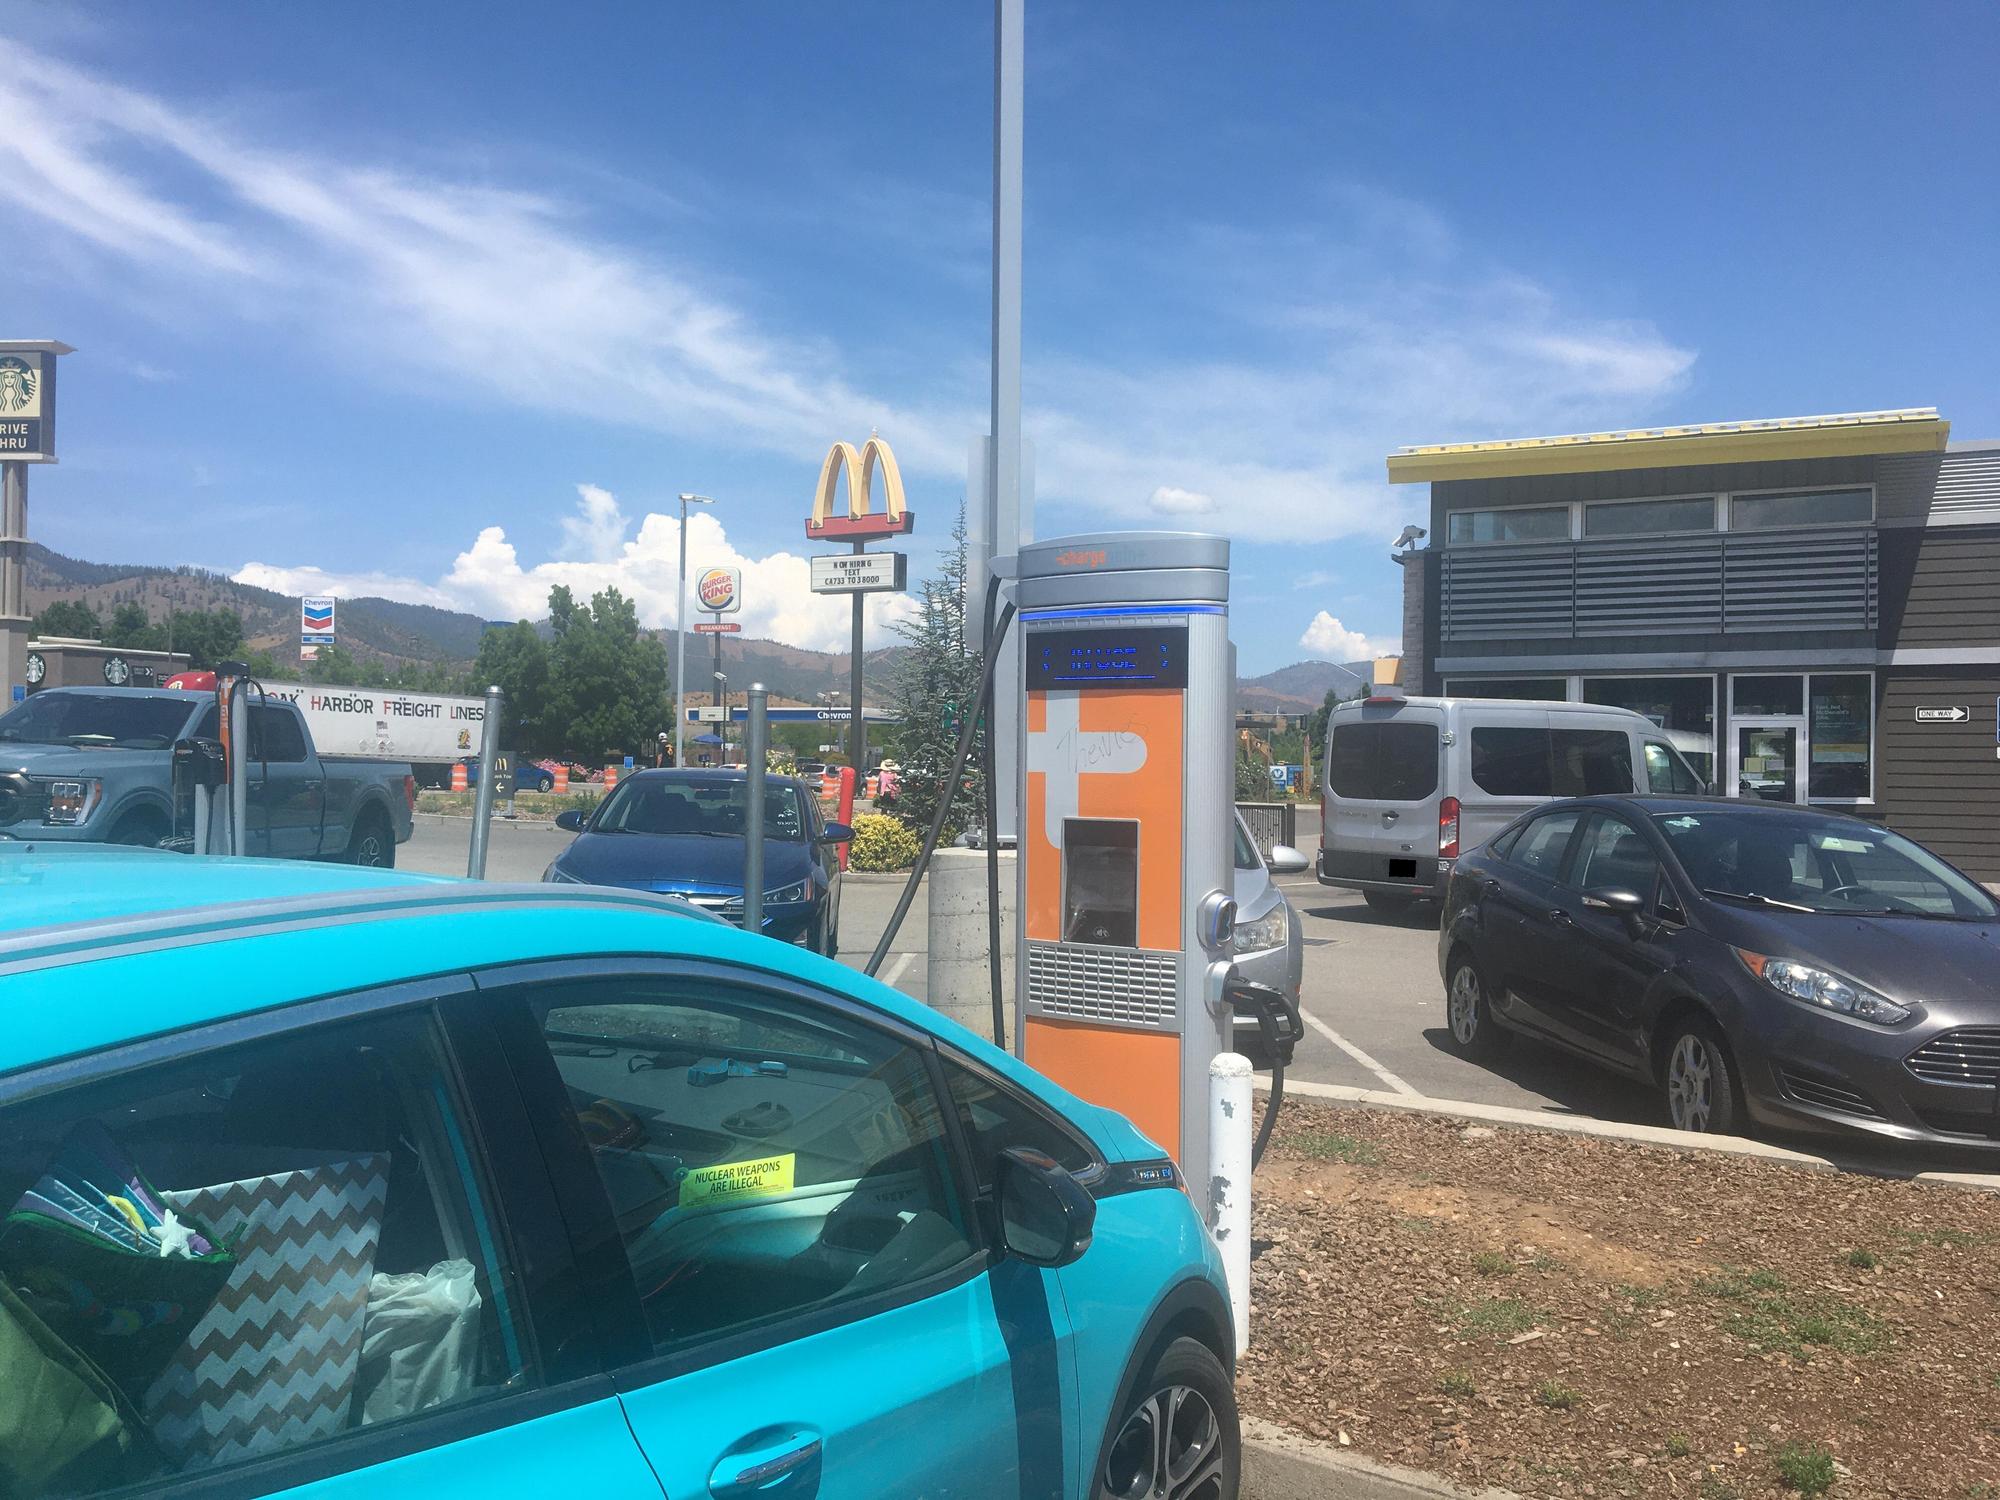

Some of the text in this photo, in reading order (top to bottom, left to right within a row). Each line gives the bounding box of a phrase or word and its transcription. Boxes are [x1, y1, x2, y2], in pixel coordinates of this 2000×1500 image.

[0, 423, 28, 435] RIVE
[0, 437, 27, 449] HRU
[844, 568, 861, 576] TEXT
[701, 575, 732, 592] BURGER
[703, 583, 733, 601] KING
[310, 694, 374, 714] HARBOR
[383, 699, 442, 719] FREIGHT
[450, 704, 484, 721] LINES
[1920, 710, 1952, 718] ONE WAY
[817, 711, 852, 720] Chevron
[695, 1161, 780, 1184] NUCLEAR WEAPONS
[709, 1176, 763, 1194] ARE ILLEGAL
